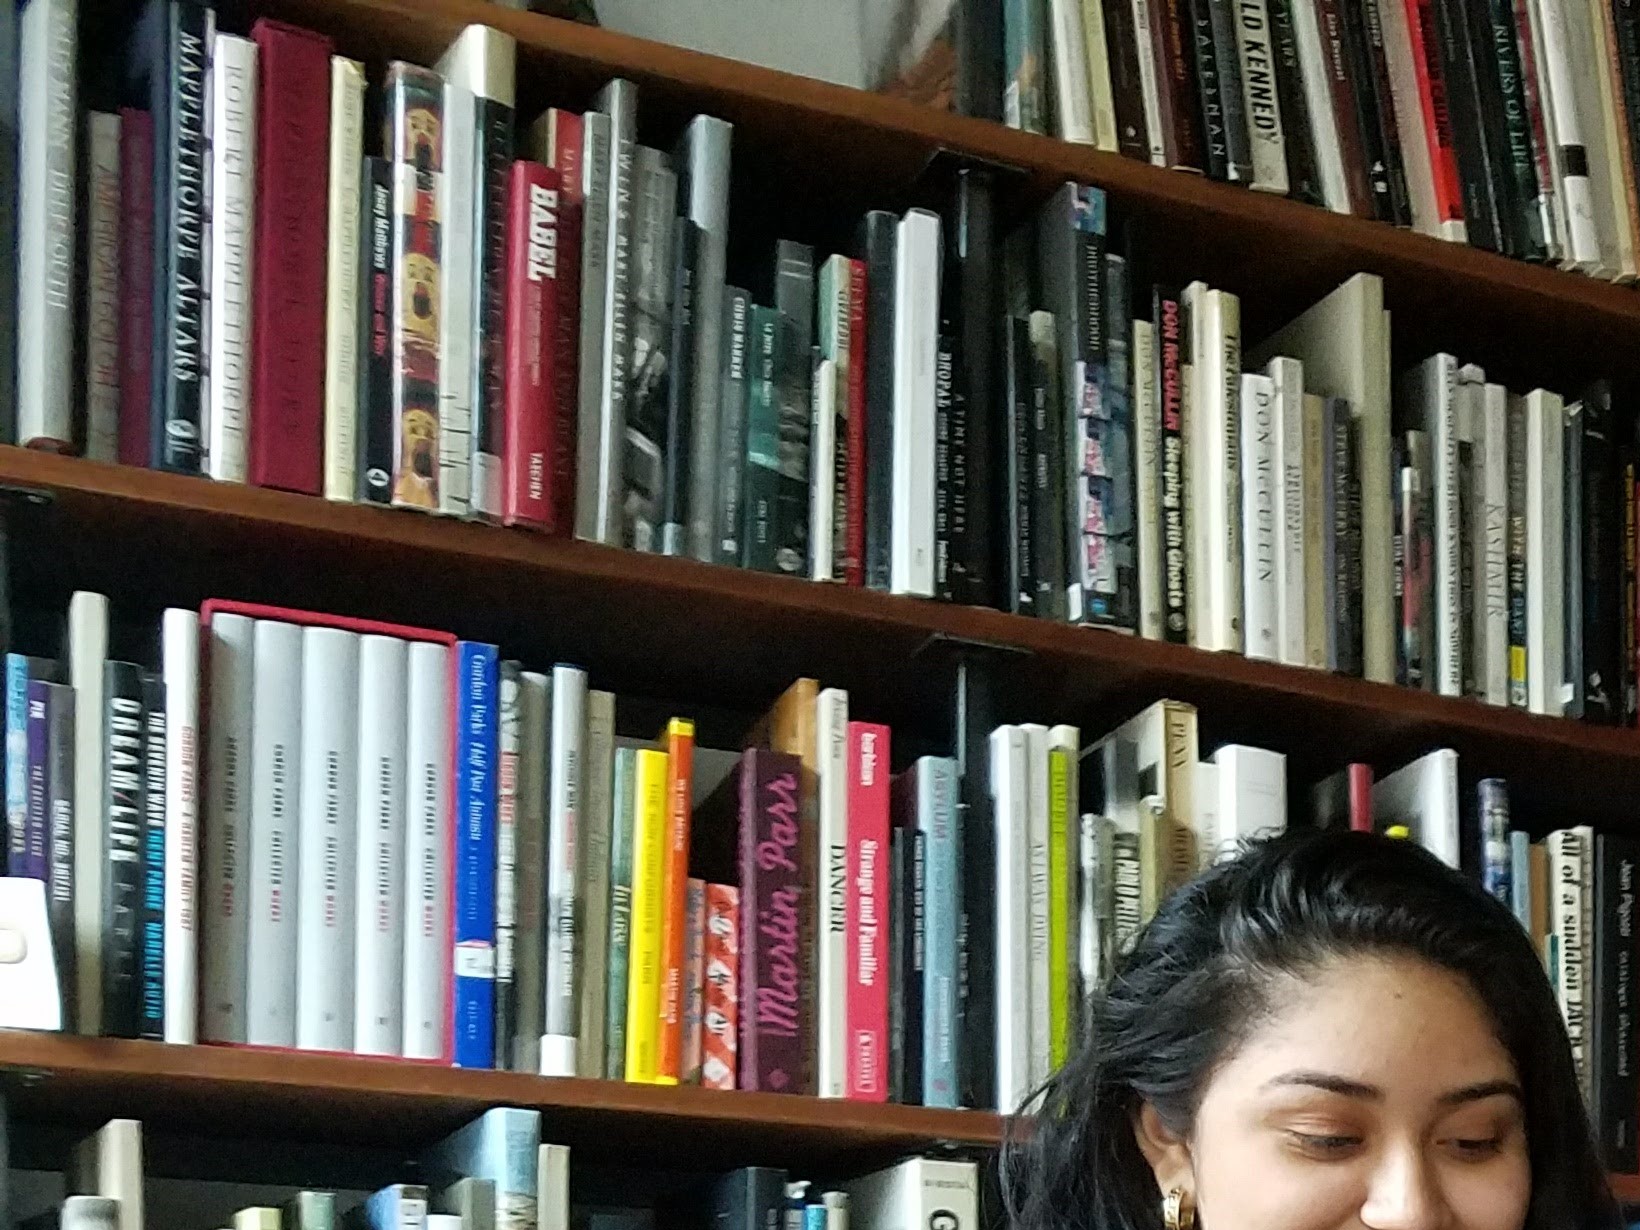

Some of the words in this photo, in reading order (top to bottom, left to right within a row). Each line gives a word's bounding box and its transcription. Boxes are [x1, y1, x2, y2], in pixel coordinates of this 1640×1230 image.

[1247, 40, 1278, 147] KENNEDY
[1493, 25, 1519, 95] RIVERS
[176, 31, 204, 259] MAPPLETHORPE
[223, 63, 247, 178] ROBERT
[1504, 100, 1521, 123] OF
[527, 182, 559, 283] BABEL
[172, 273, 200, 383] ALTARS
[221, 198, 244, 442] MAPPLETHORPE
[1161, 299, 1179, 339] DON
[1162, 341, 1180, 431] McCULLIN
[1254, 391, 1273, 444] DON
[1162, 436, 1182, 508] Sleeping
[1165, 511, 1183, 547] with
[1256, 454, 1274, 584] McCULLIN
[1165, 548, 1185, 608] Ghosts
[1486, 503, 1508, 618] KASHMIR
[466, 653, 487, 702] Gordon
[180, 726, 196, 767] GORDON
[466, 703, 487, 736] Parks
[755, 772, 799, 874] Parr
[1559, 831, 1582, 858] All
[854, 839, 879, 894] Strange
[1560, 863, 1582, 888] of
[1561, 893, 1577, 907] a
[858, 896, 877, 925] and
[757, 886, 804, 1039] Martin
[1564, 913, 1585, 991] sudden
